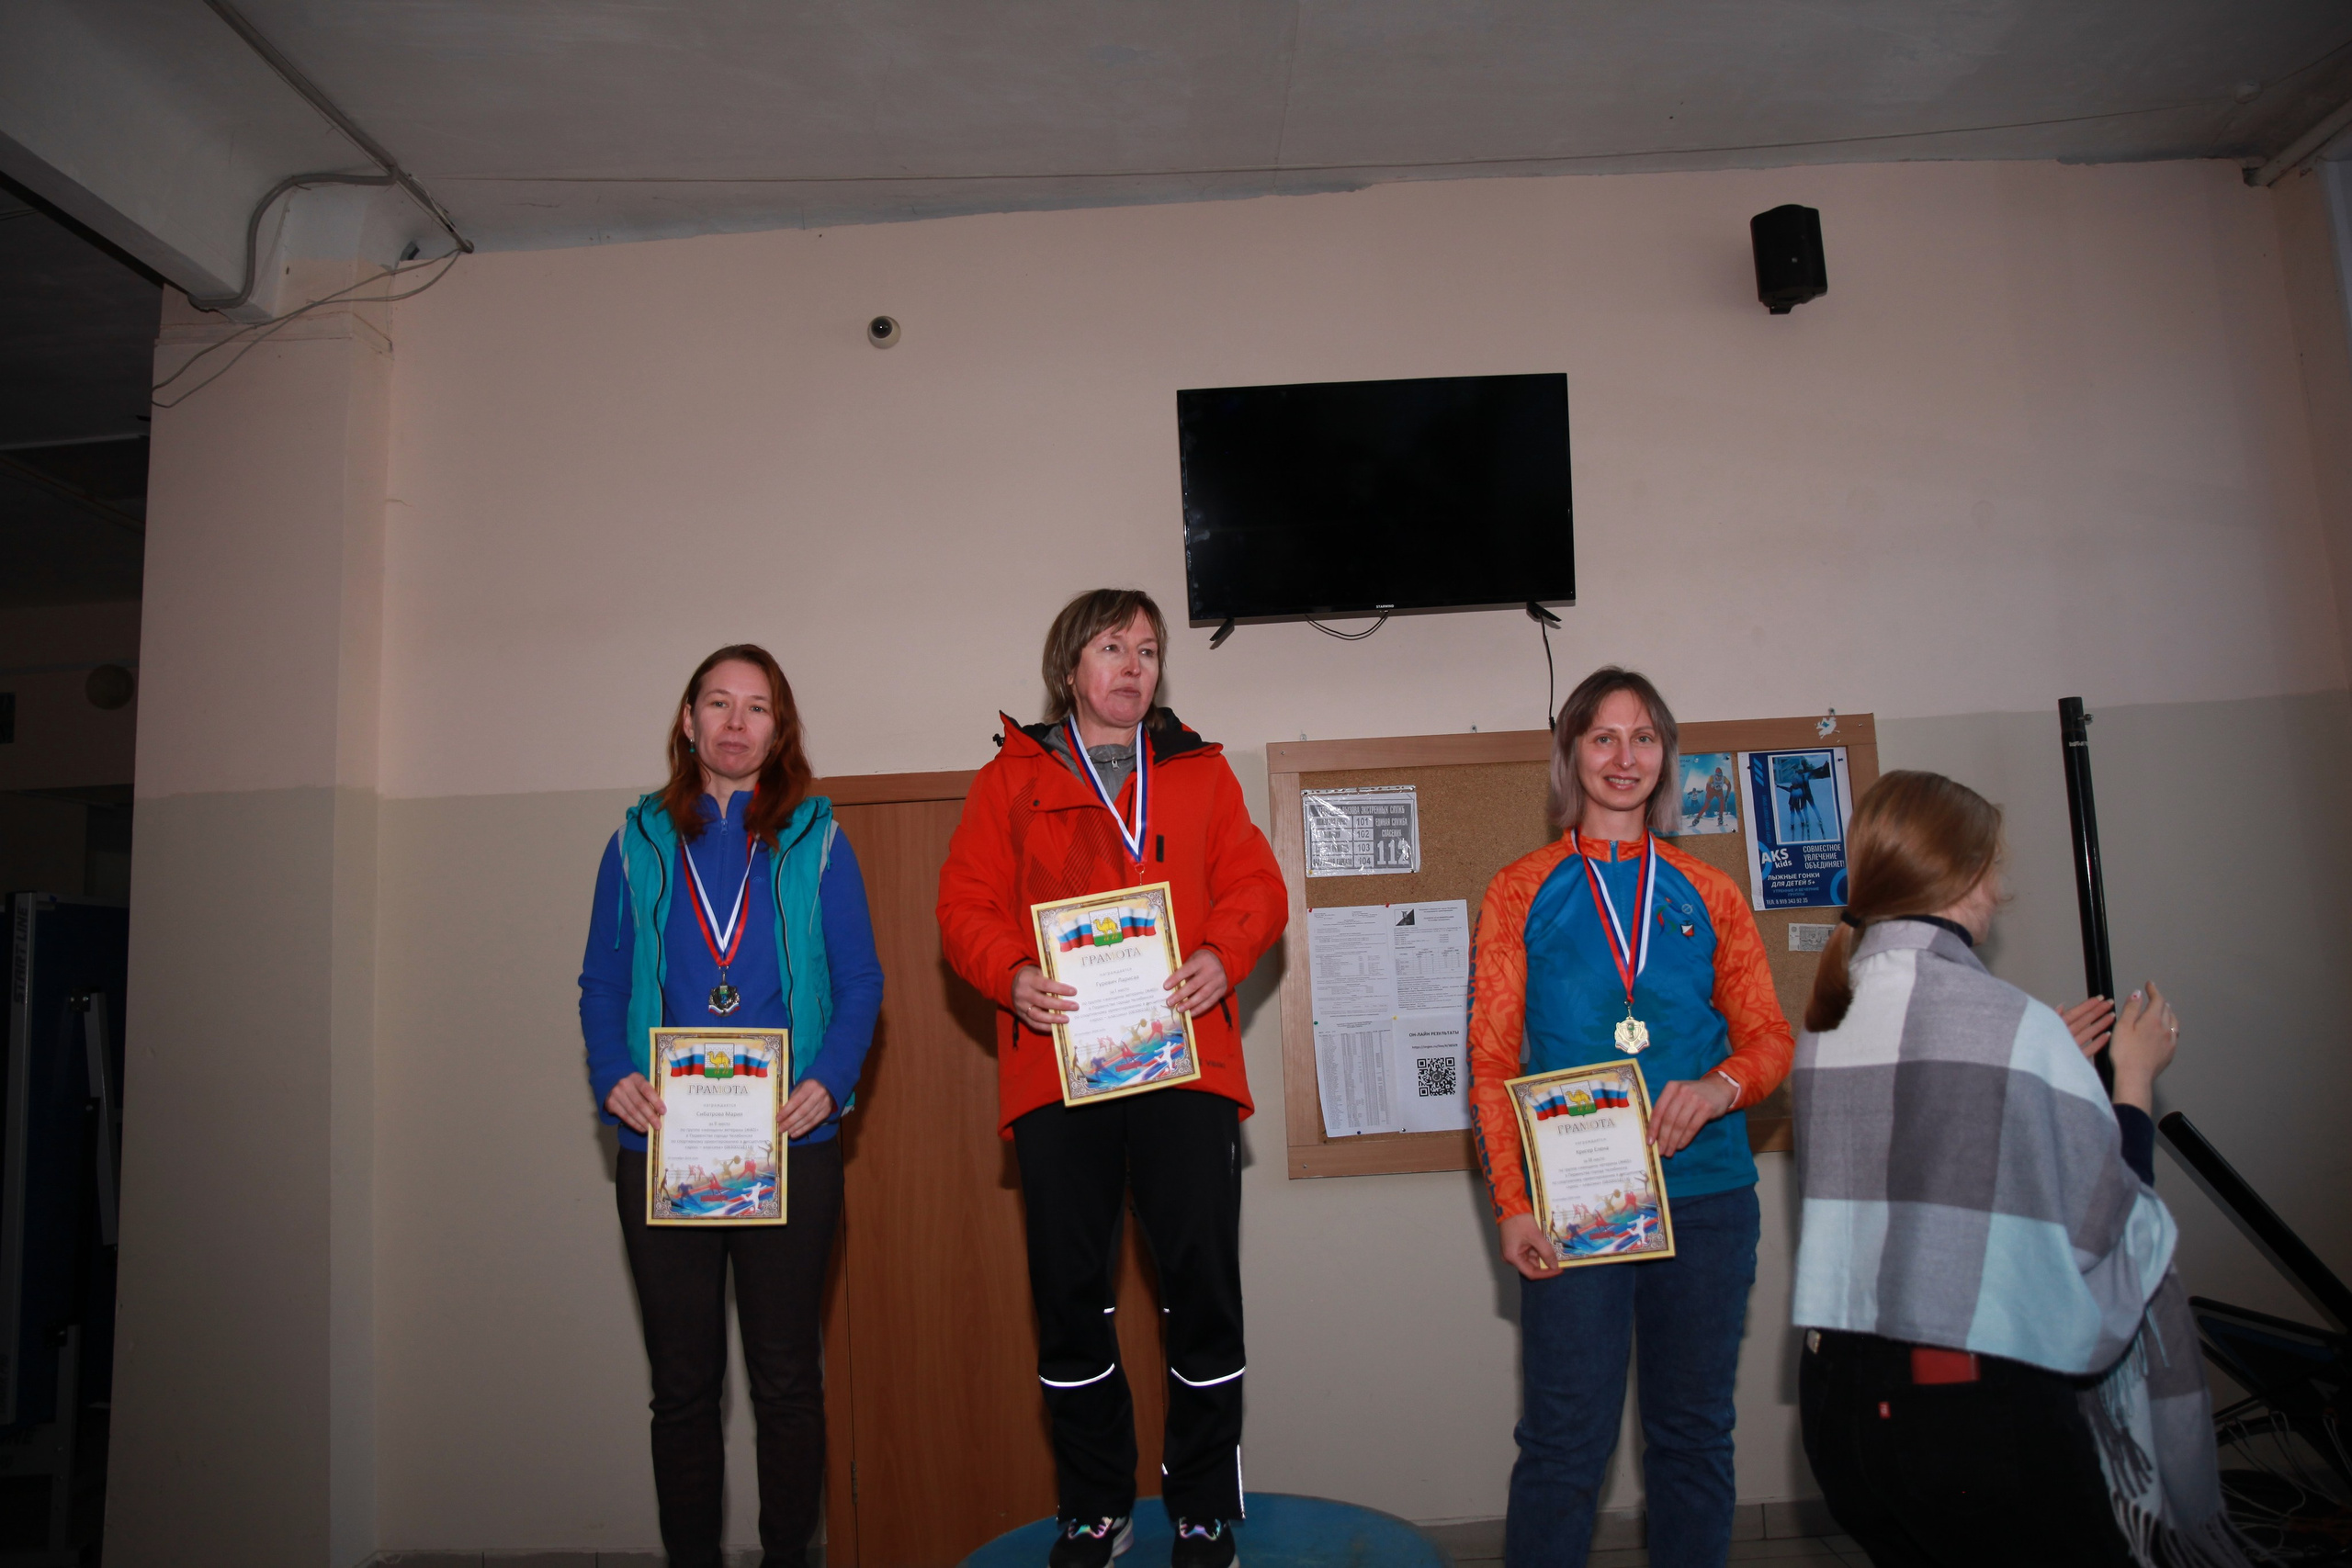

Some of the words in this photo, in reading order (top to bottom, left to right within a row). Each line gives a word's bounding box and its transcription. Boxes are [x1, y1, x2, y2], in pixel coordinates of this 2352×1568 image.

[1356, 818, 1369, 826] 101
[1357, 830, 1370, 839] 102
[1358, 843, 1371, 852] 103
[1377, 840, 1410, 865] 112
[1803, 843, 1841, 853] СОВМЕСТНОЕ
[1761, 848, 1789, 864] AKS
[1804, 852, 1838, 862] УВЛЕЧЕНИЕ
[1359, 857, 1372, 866] 104
[1775, 860, 1792, 869] kids
[1804, 860, 1845, 869] ОБЪЕДИНЯЕТ!
[1768, 873, 1797, 881] ЛЫЖНЫЕ
[1786, 879, 1806, 887] ДЕТЕЙ
[16, 905, 28, 942] LINE
[1080, 947, 1141, 966] ГРАМОТА
[13, 944, 27, 1004] START
[687, 1084, 749, 1095] ГРАМОТА
[1557, 1118, 1615, 1135] ГРАМОТА
